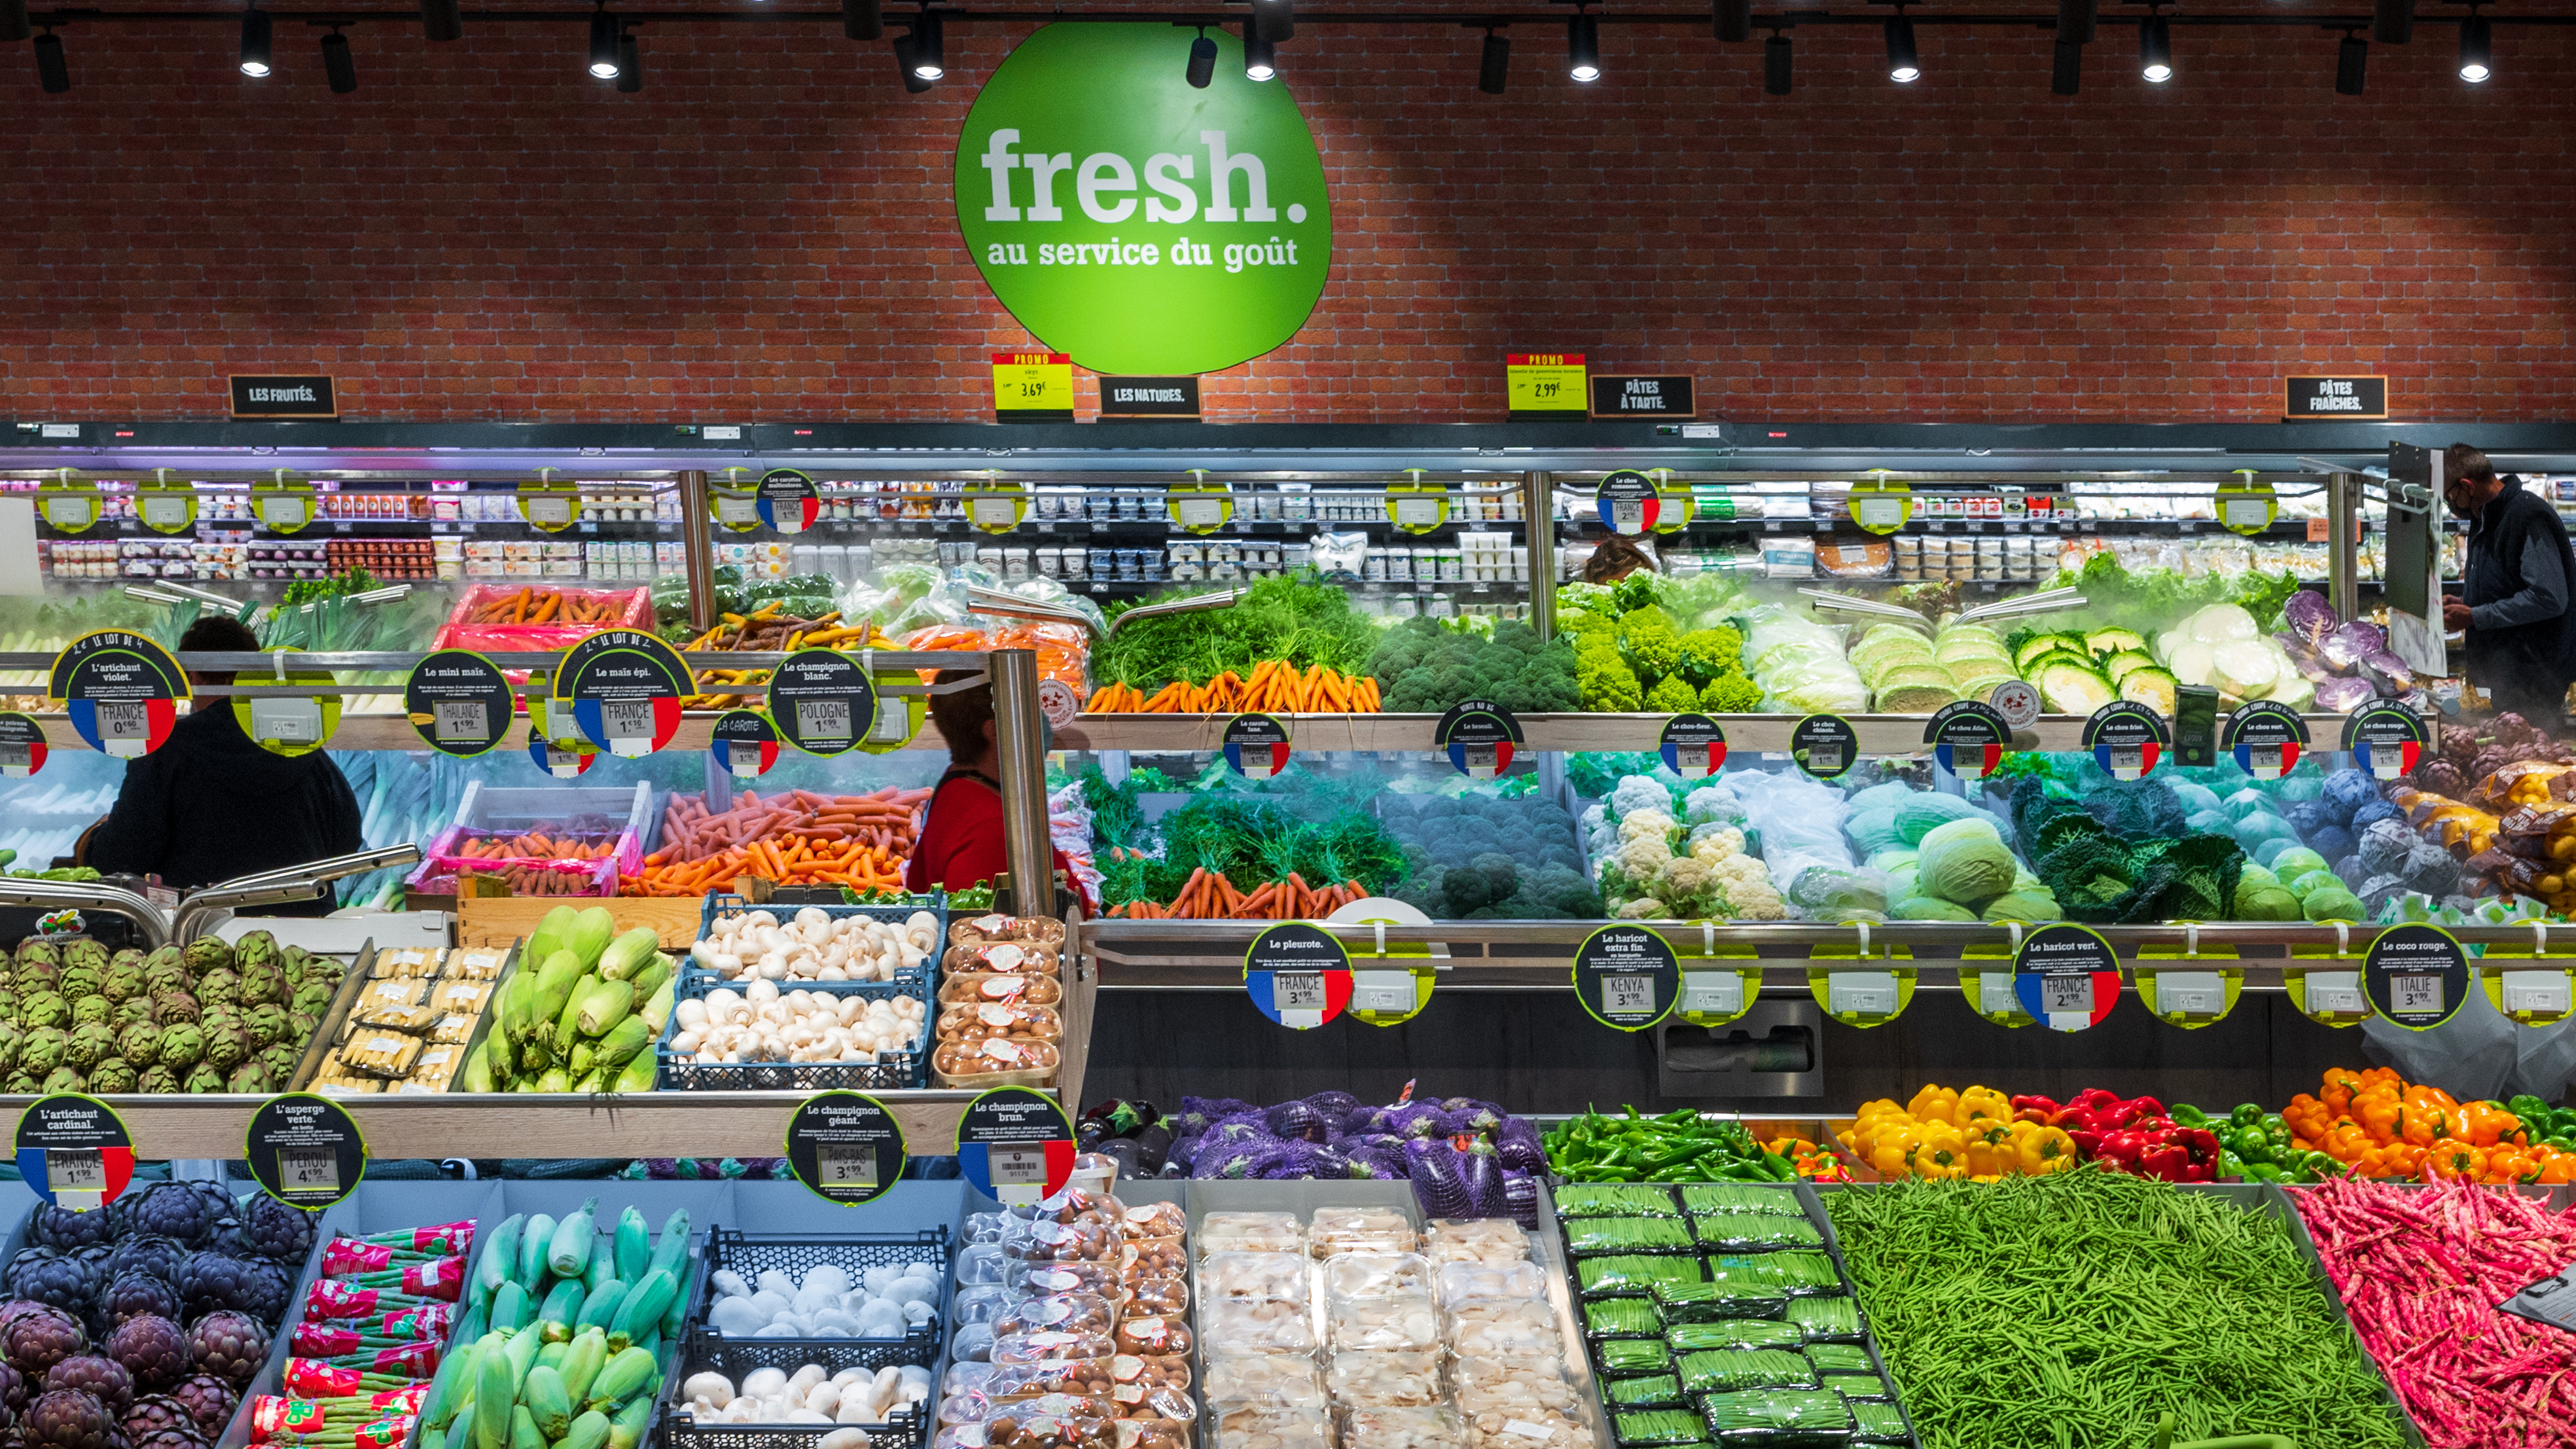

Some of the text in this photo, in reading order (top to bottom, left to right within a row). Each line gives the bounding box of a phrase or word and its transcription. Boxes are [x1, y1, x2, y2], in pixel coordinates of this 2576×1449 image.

[981, 128, 1307, 224] fresh.
[988, 236, 1298, 273] au service du goût
[1014, 354, 1048, 365] PROMO
[1529, 355, 1564, 365] PROMO
[1626, 380, 1658, 394] PÂTES
[2319, 379, 2353, 395] PÂTES
[249, 385, 317, 402] LES FRUITÉS.
[1114, 389, 1185, 402] LES NATURES.
[1620, 393, 1666, 410] À TARTE.
[2310, 394, 2363, 410] FRAÎCHES.
[776, 501, 800, 511] FRANCE
[1616, 503, 1640, 512] FRANCE
[93, 636, 102, 647] LE
[105, 634, 119, 645] LOT
[124, 635, 132, 647] DE
[600, 635, 609, 646] LE
[612, 633, 627, 644] LOT
[631, 635, 639, 646] DE
[643, 639, 652, 648] 2
[92, 664, 141, 672] L'artichaut
[425, 668, 487, 677] Le mini maïs.
[596, 668, 651, 678] Le maïs épi.
[784, 662, 850, 672] Le champignon
[103, 673, 132, 682] violet.
[804, 671, 832, 681] blanc.
[103, 706, 144, 721] FRANCE
[609, 704, 650, 719] FRANCE
[800, 703, 849, 719] POLOGNE
[717, 720, 760, 732] LA CAROTTE
[1270, 940, 1324, 950] Le pleurote.
[2030, 942, 2098, 952] Le haricot vert.
[2382, 942, 2393, 951] Le
[2419, 942, 2448, 952] rouge.
[1279, 976, 1320, 990] FRANCE
[1611, 978, 1645, 992] KENYA
[2046, 978, 2087, 993] FRANCE
[2400, 978, 2431, 992] ITALIE
[276, 1105, 325, 1115] L'asperge
[807, 1106, 880, 1117] Le champignon
[975, 1102, 1047, 1113] Le champignon
[40, 1109, 98, 1119] L'artichaut
[999, 1113, 1026, 1122] brun.
[47, 1120, 95, 1130] cardinal.
[829, 1117, 860, 1127] géant.
[54, 1153, 100, 1169] FRANCE
[289, 1152, 327, 1168] PEROU
[828, 1149, 866, 1164] PAYS-BAS
